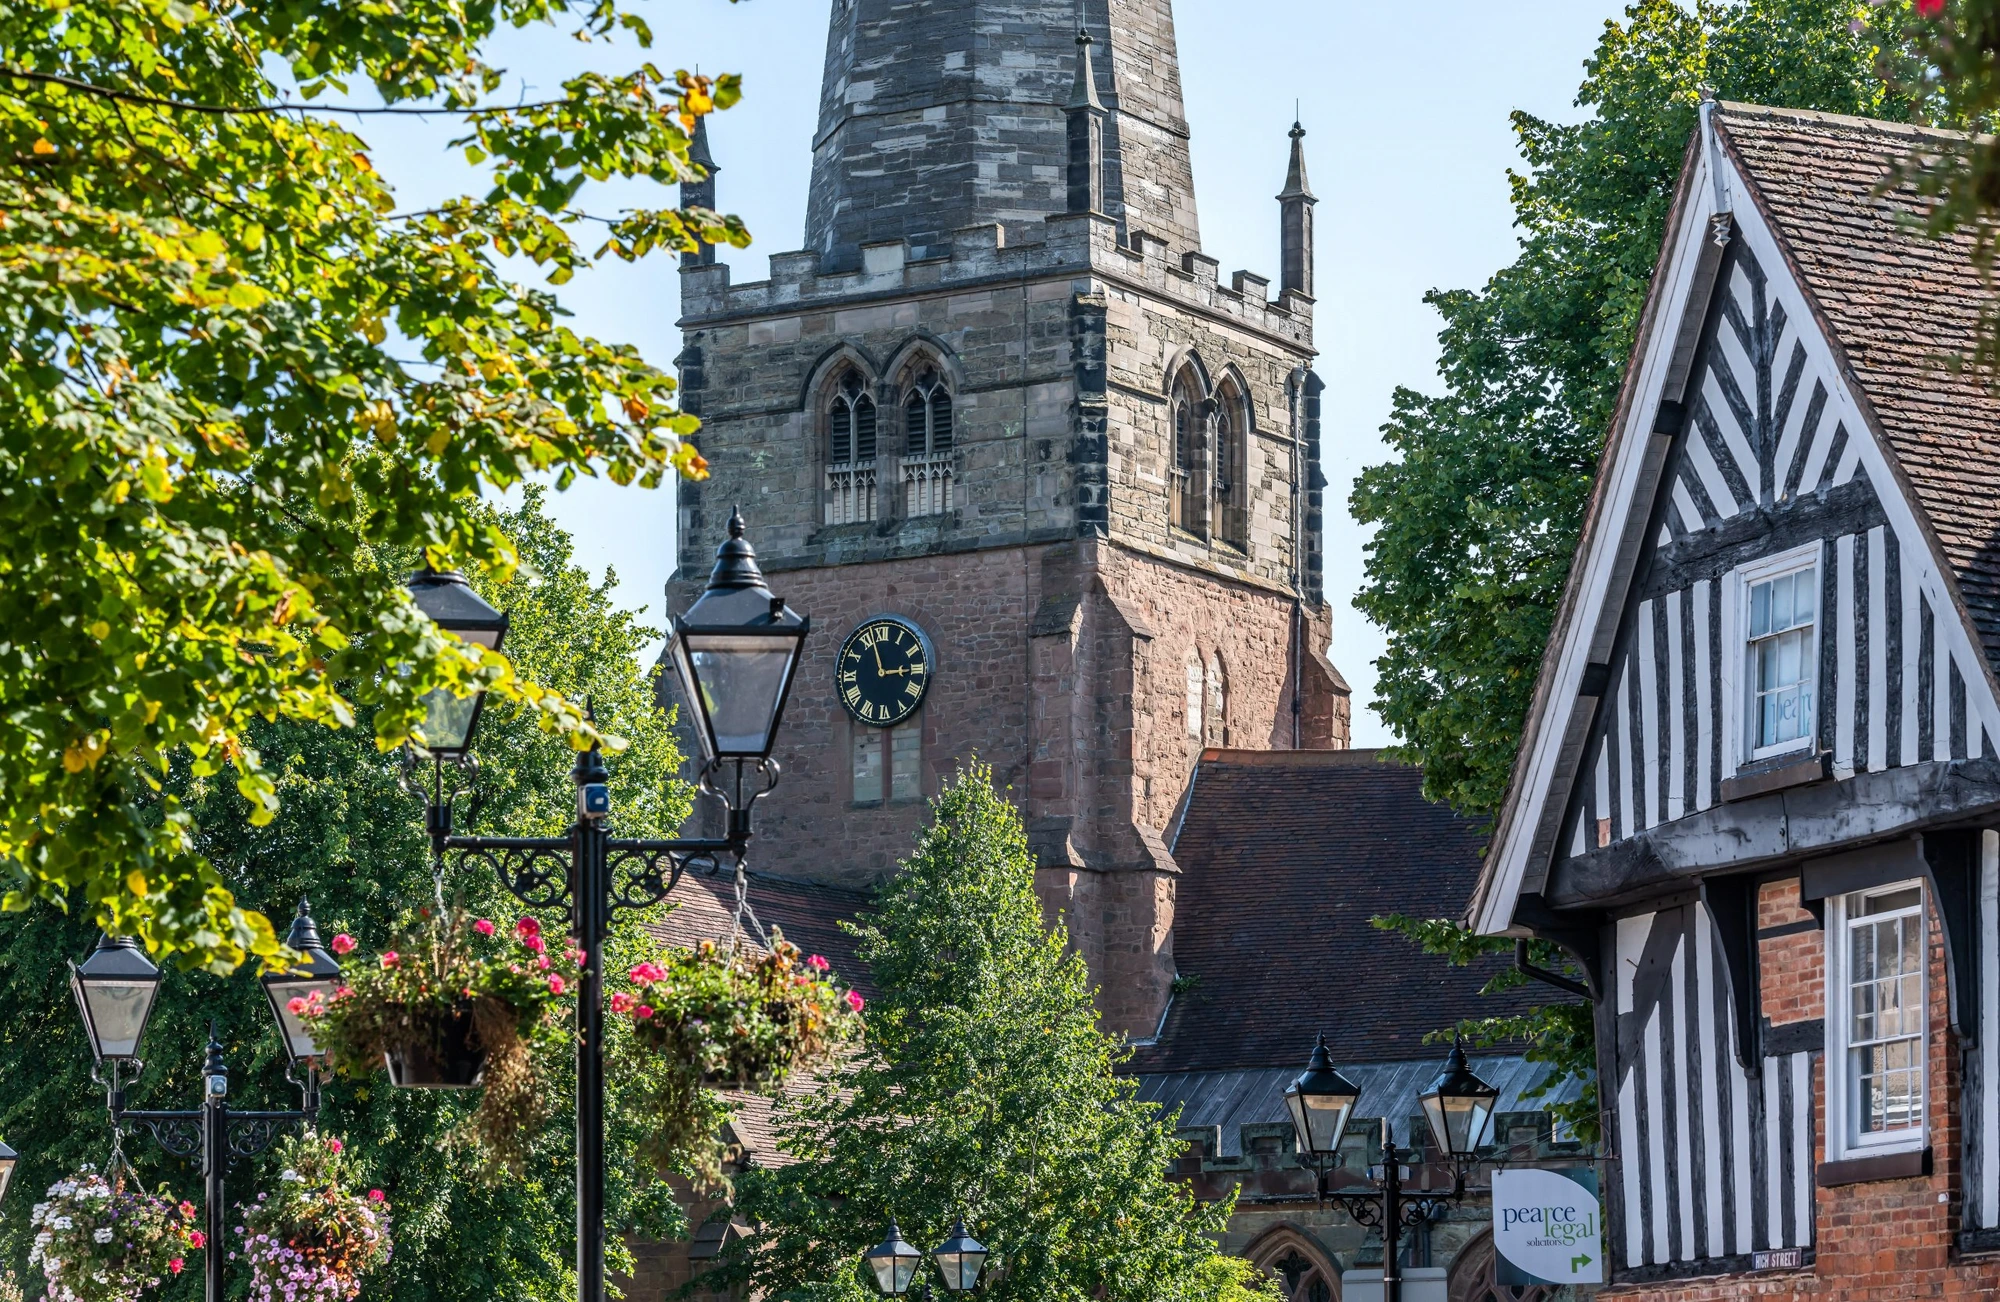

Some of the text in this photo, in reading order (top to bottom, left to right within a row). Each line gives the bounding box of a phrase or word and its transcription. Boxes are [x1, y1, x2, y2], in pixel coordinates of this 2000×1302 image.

[859, 632, 874, 651] XI
[874, 626, 889, 642] XII
[895, 630, 905, 645] I
[847, 649, 862, 663] X
[905, 643, 920, 658] II
[843, 670, 857, 682] IX
[910, 662, 924, 675] III
[846, 684, 861, 707] VIII
[859, 699, 874, 718] VII
[879, 705, 891, 719] VI
[897, 699, 907, 713] V
[1502, 1206, 1576, 1231] pearce
[1543, 1210, 1595, 1246] legal
[1526, 1237, 1563, 1247] solicitors
[1755, 1251, 1797, 1269] HIGH STREET
